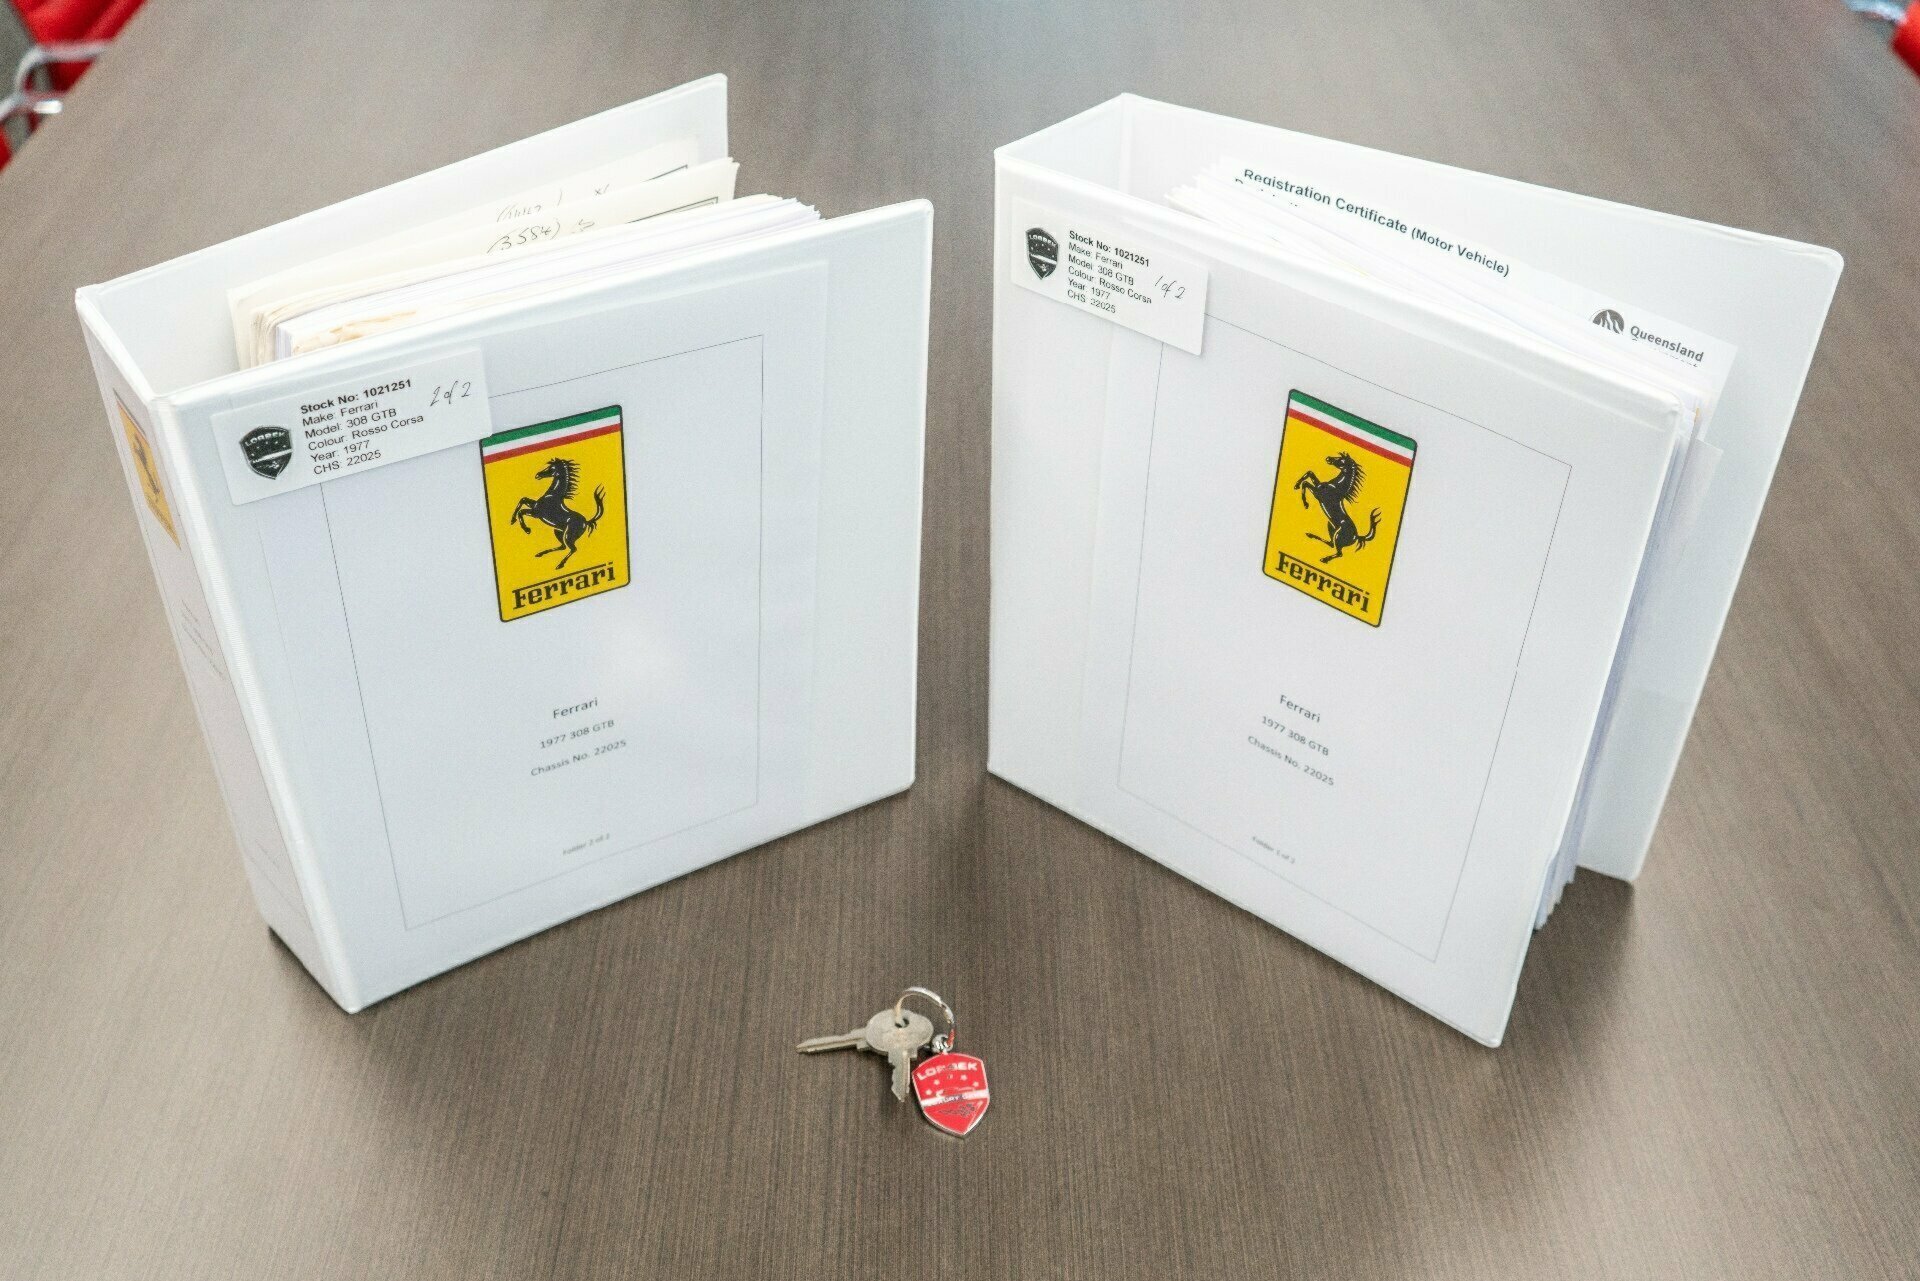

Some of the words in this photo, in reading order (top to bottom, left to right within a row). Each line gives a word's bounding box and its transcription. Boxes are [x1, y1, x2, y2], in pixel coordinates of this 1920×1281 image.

[1243, 169, 1331, 205] Registration
[1335, 197, 1408, 234] Certificate
[1411, 226, 1454, 252] (Motor
[1457, 244, 1510, 278] Vehicle)
[1068, 242, 1093, 258] Make:
[1095, 252, 1123, 269] Ferrari
[1069, 230, 1094, 247] Stock
[1096, 240, 1111, 253] No:
[1114, 247, 1150, 267] 1021251
[1097, 265, 1113, 278] 308
[1115, 272, 1134, 286] GTB
[1162, 279, 1177, 299] of
[1177, 286, 1187, 300] 2
[1090, 298, 1116, 314] 22025
[1092, 287, 1111, 300] 1977
[1099, 278, 1126, 295] Rosso
[1127, 288, 1152, 304] Corsa
[1630, 325, 1705, 362] Queensland
[300, 399, 335, 415] Stock
[338, 394, 359, 405] No:
[363, 379, 412, 398] 1021251
[443, 380, 459, 405] of
[460, 381, 472, 398] 2
[302, 413, 336, 427] Make:
[340, 400, 379, 417] Ferrari
[305, 423, 343, 439] Model:
[346, 416, 368, 428] 308
[371, 408, 397, 422] GTB
[308, 435, 348, 451] Colour:
[351, 424, 388, 440] Rosso
[390, 415, 424, 429] Corsa
[310, 450, 340, 463] Year:
[343, 440, 371, 454] 1977
[313, 460, 343, 475] CHS:
[346, 449, 382, 467] 22025
[512, 561, 616, 610] Ferrari
[1275, 551, 1370, 613] Ferrari
[552, 697, 599, 719] Ferrari
[1279, 694, 1321, 723] Ferrari
[539, 733, 567, 750] 1977
[570, 726, 590, 740] 308
[592, 719, 615, 733] GTB
[1261, 715, 1286, 734] 1977
[1287, 729, 1307, 746] 308
[1308, 740, 1330, 757] GTB
[530, 758, 570, 777] Chassis
[572, 753, 591, 764] No.
[593, 739, 627, 756] 22025
[1247, 735, 1283, 760] Chassis
[1284, 754, 1302, 770] No.
[1303, 765, 1335, 787] 22025
